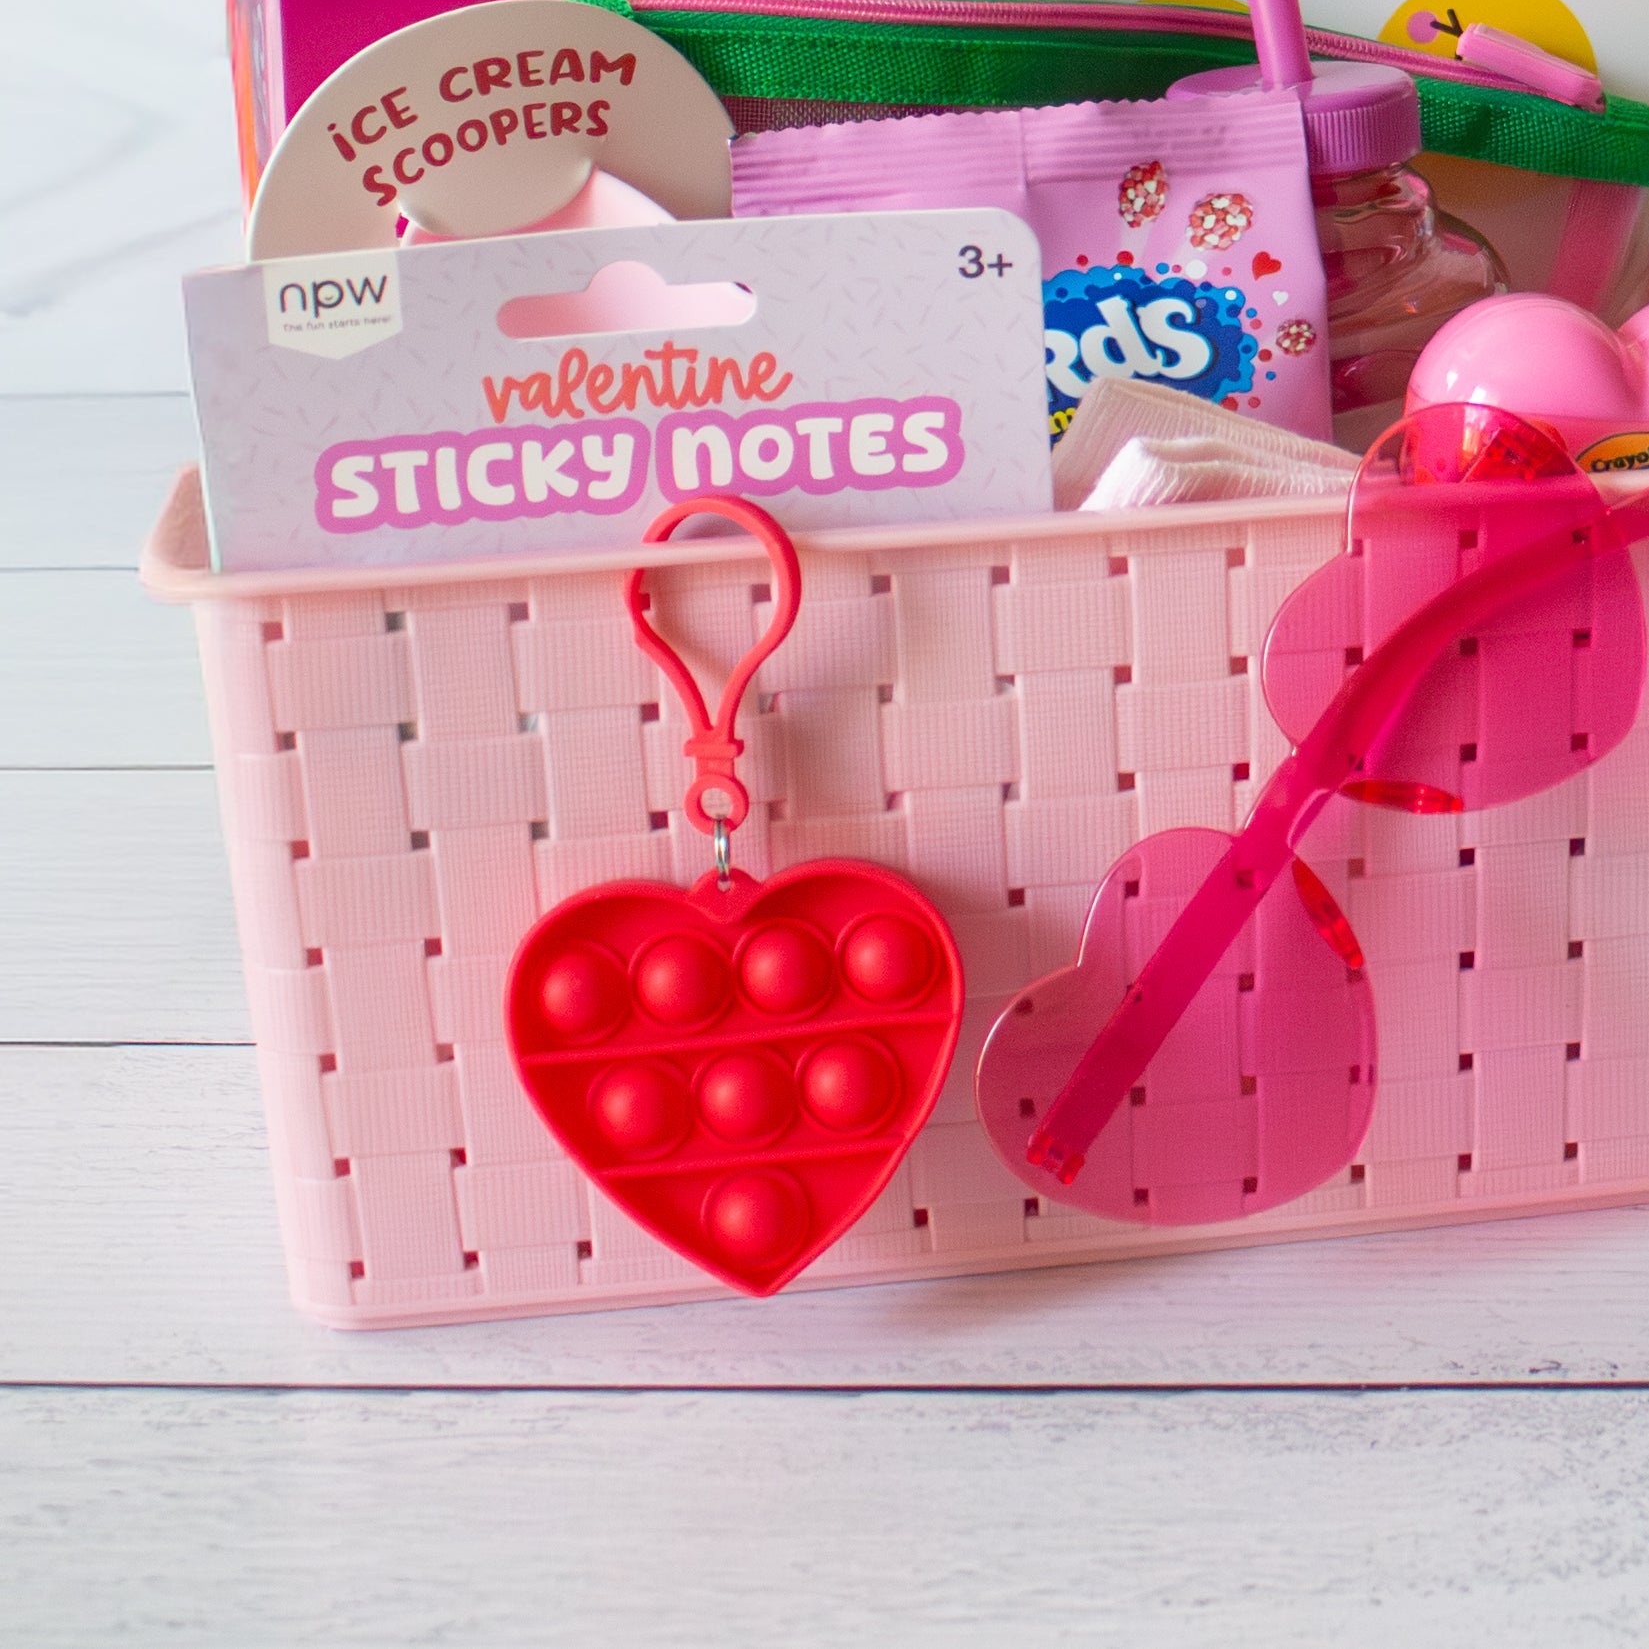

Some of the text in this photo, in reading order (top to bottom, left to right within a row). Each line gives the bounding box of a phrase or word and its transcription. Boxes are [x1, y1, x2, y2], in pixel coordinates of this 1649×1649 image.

[438, 48, 637, 103] CREAM
[362, 99, 612, 208] SCOOPERS
[957, 245, 1013, 279] 3+
[279, 274, 388, 319] npw
[481, 340, 793, 423] valentine
